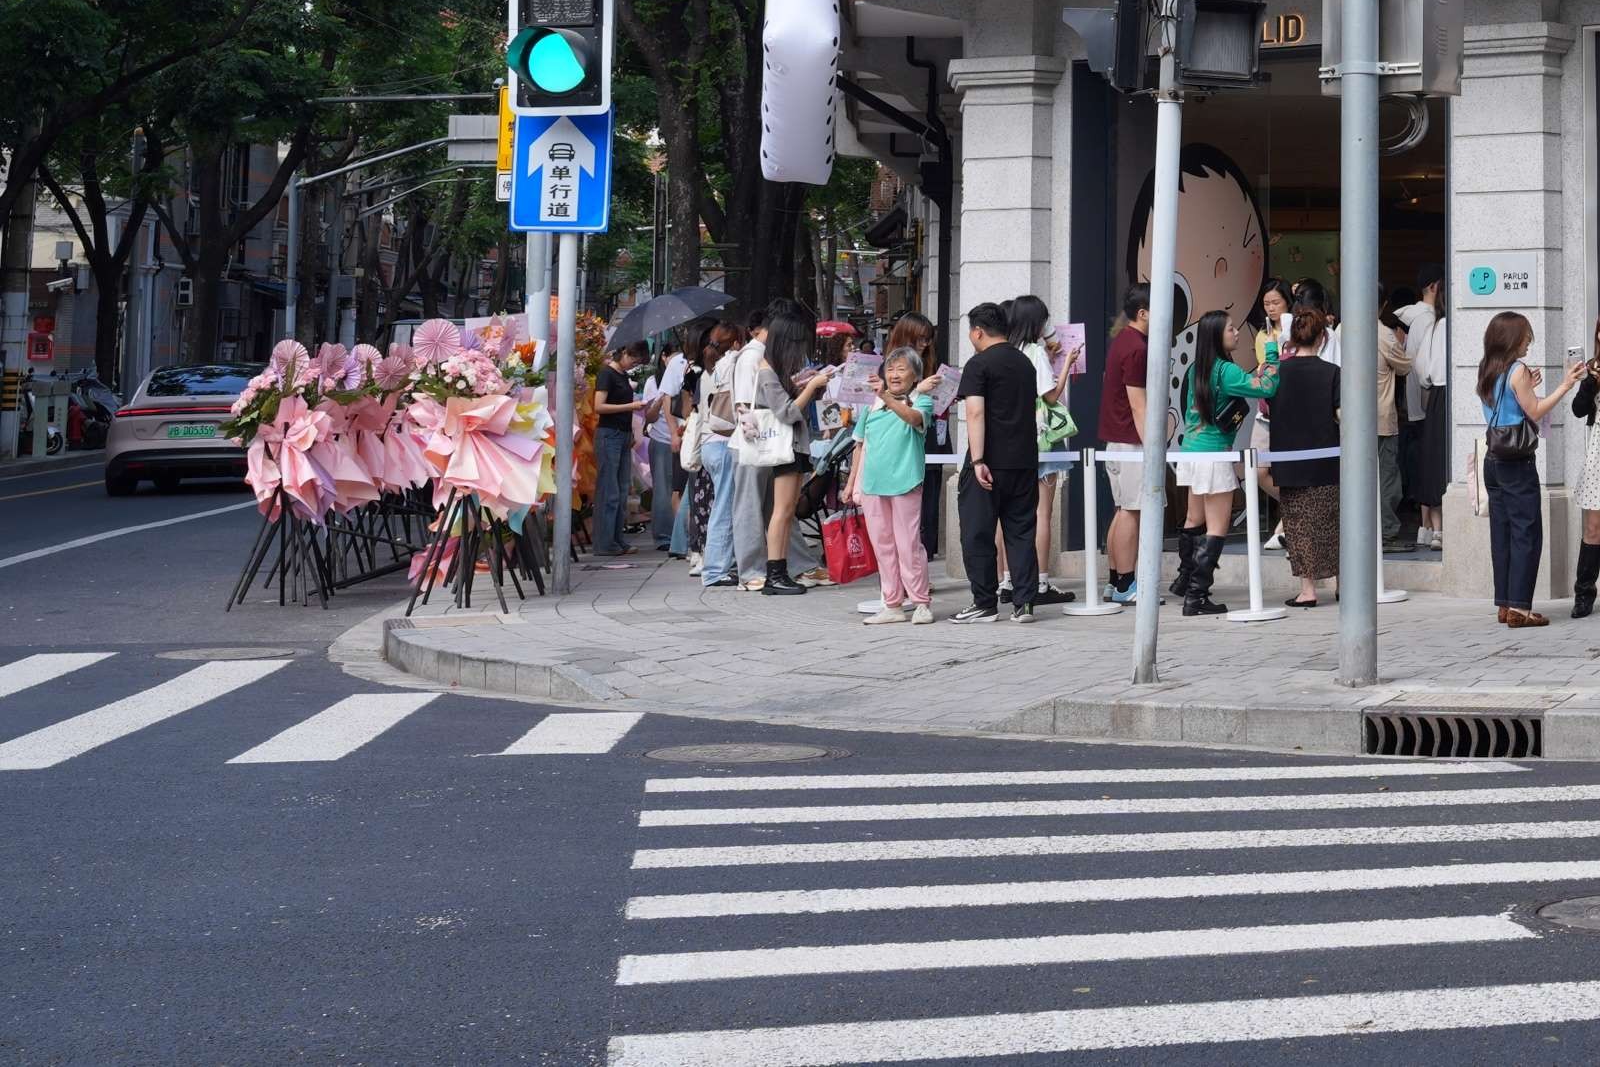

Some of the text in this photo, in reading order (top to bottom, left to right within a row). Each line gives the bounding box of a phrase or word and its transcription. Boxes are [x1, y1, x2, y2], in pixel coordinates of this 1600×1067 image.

[1260, 15, 1304, 44] LID
[548, 166, 572, 217] 单行道
[1503, 272, 1529, 280] PARLID
